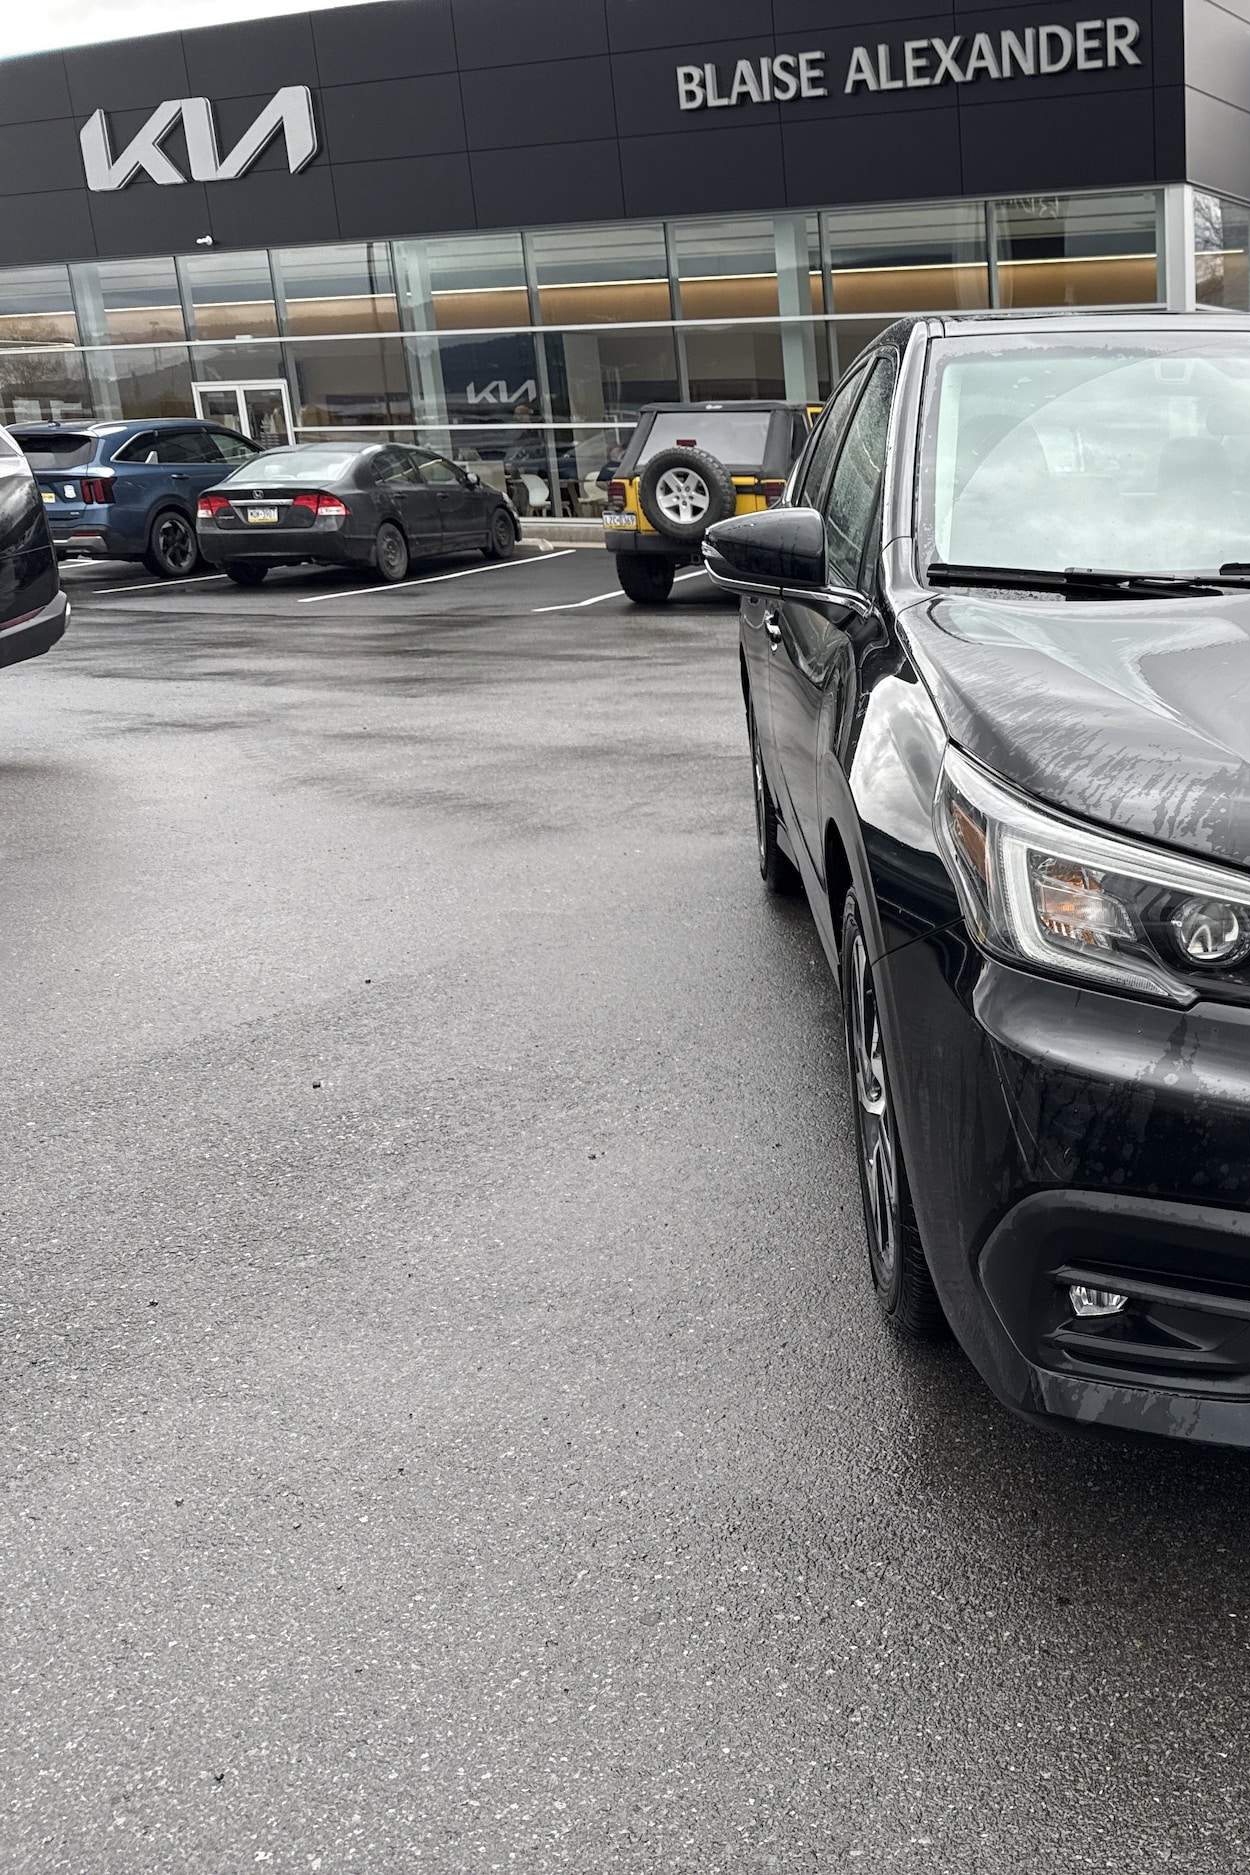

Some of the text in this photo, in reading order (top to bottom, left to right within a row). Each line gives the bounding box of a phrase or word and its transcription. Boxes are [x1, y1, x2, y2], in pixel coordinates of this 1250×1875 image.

[676, 16, 1142, 110] BLAISE ALEXANDER
[80, 85, 317, 191] KIA
[466, 380, 536, 404] KIA
